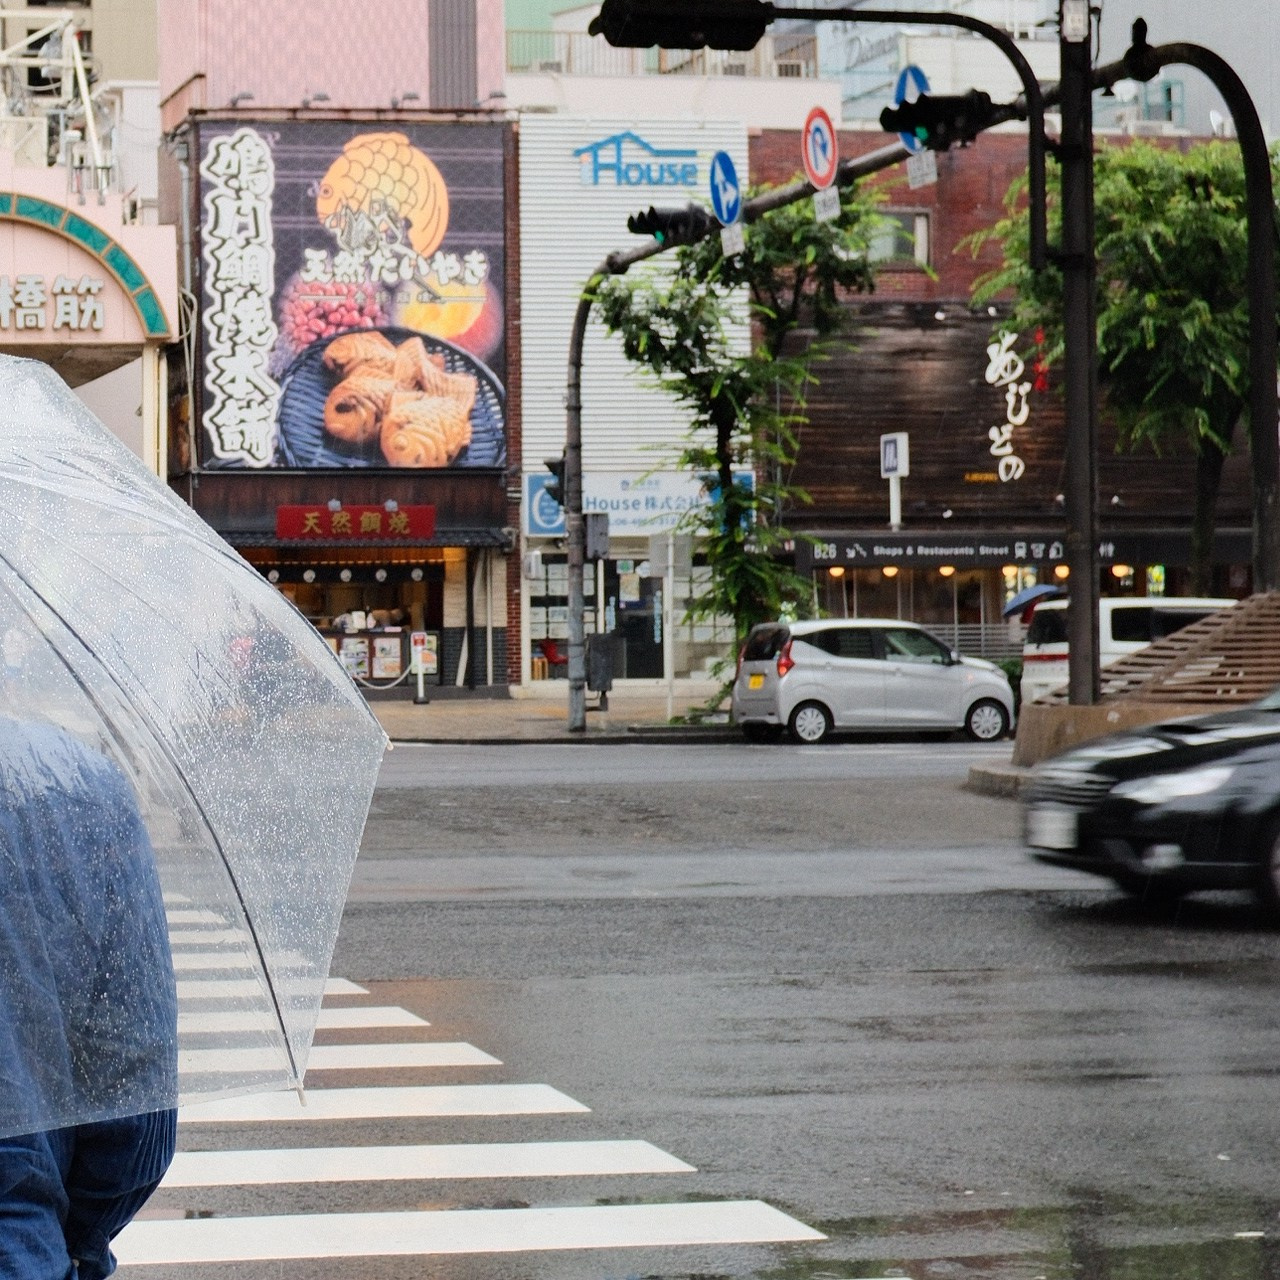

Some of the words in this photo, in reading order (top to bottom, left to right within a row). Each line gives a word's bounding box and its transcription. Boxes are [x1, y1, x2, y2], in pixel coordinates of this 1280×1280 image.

[578, 131, 697, 186] House
[300, 248, 487, 285] 天然たいやき
[204, 130, 277, 464] 鳴門鯛焼本舗
[302, 511, 410, 534] 天然鯛焼
[917, 545, 975, 556] Restaurants
[979, 545, 1009, 556] Street
